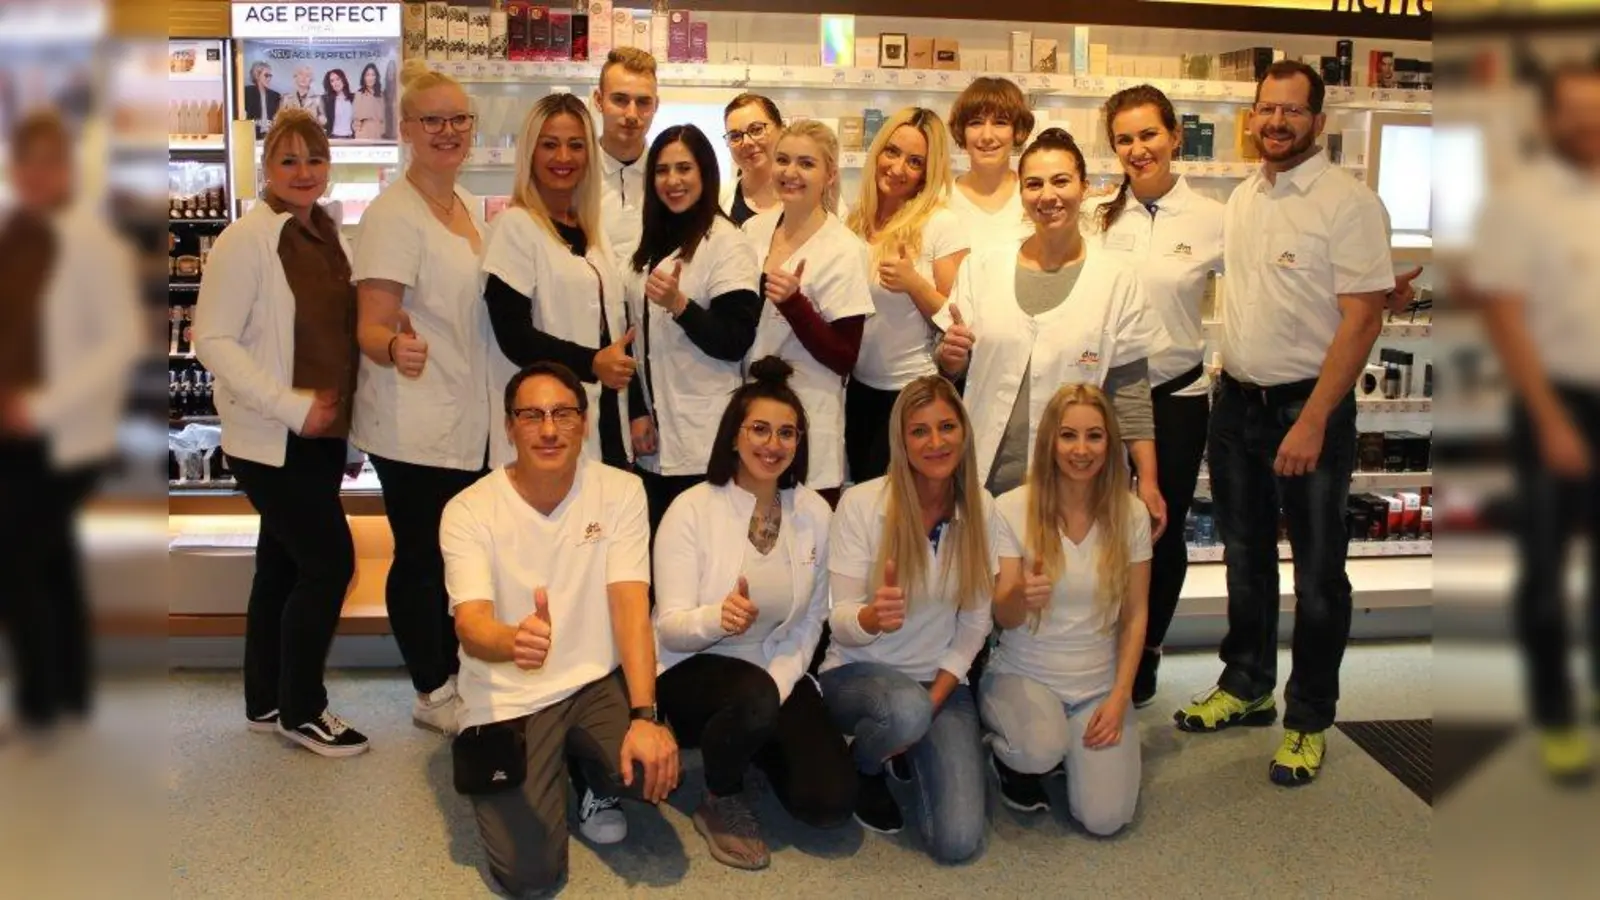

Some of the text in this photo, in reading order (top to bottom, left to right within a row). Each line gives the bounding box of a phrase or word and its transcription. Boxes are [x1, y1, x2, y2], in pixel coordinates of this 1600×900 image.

[245, 6, 387, 22] AGE PERFECT
[292, 51, 312, 60] AGE
[315, 50, 356, 60] PERFECT
